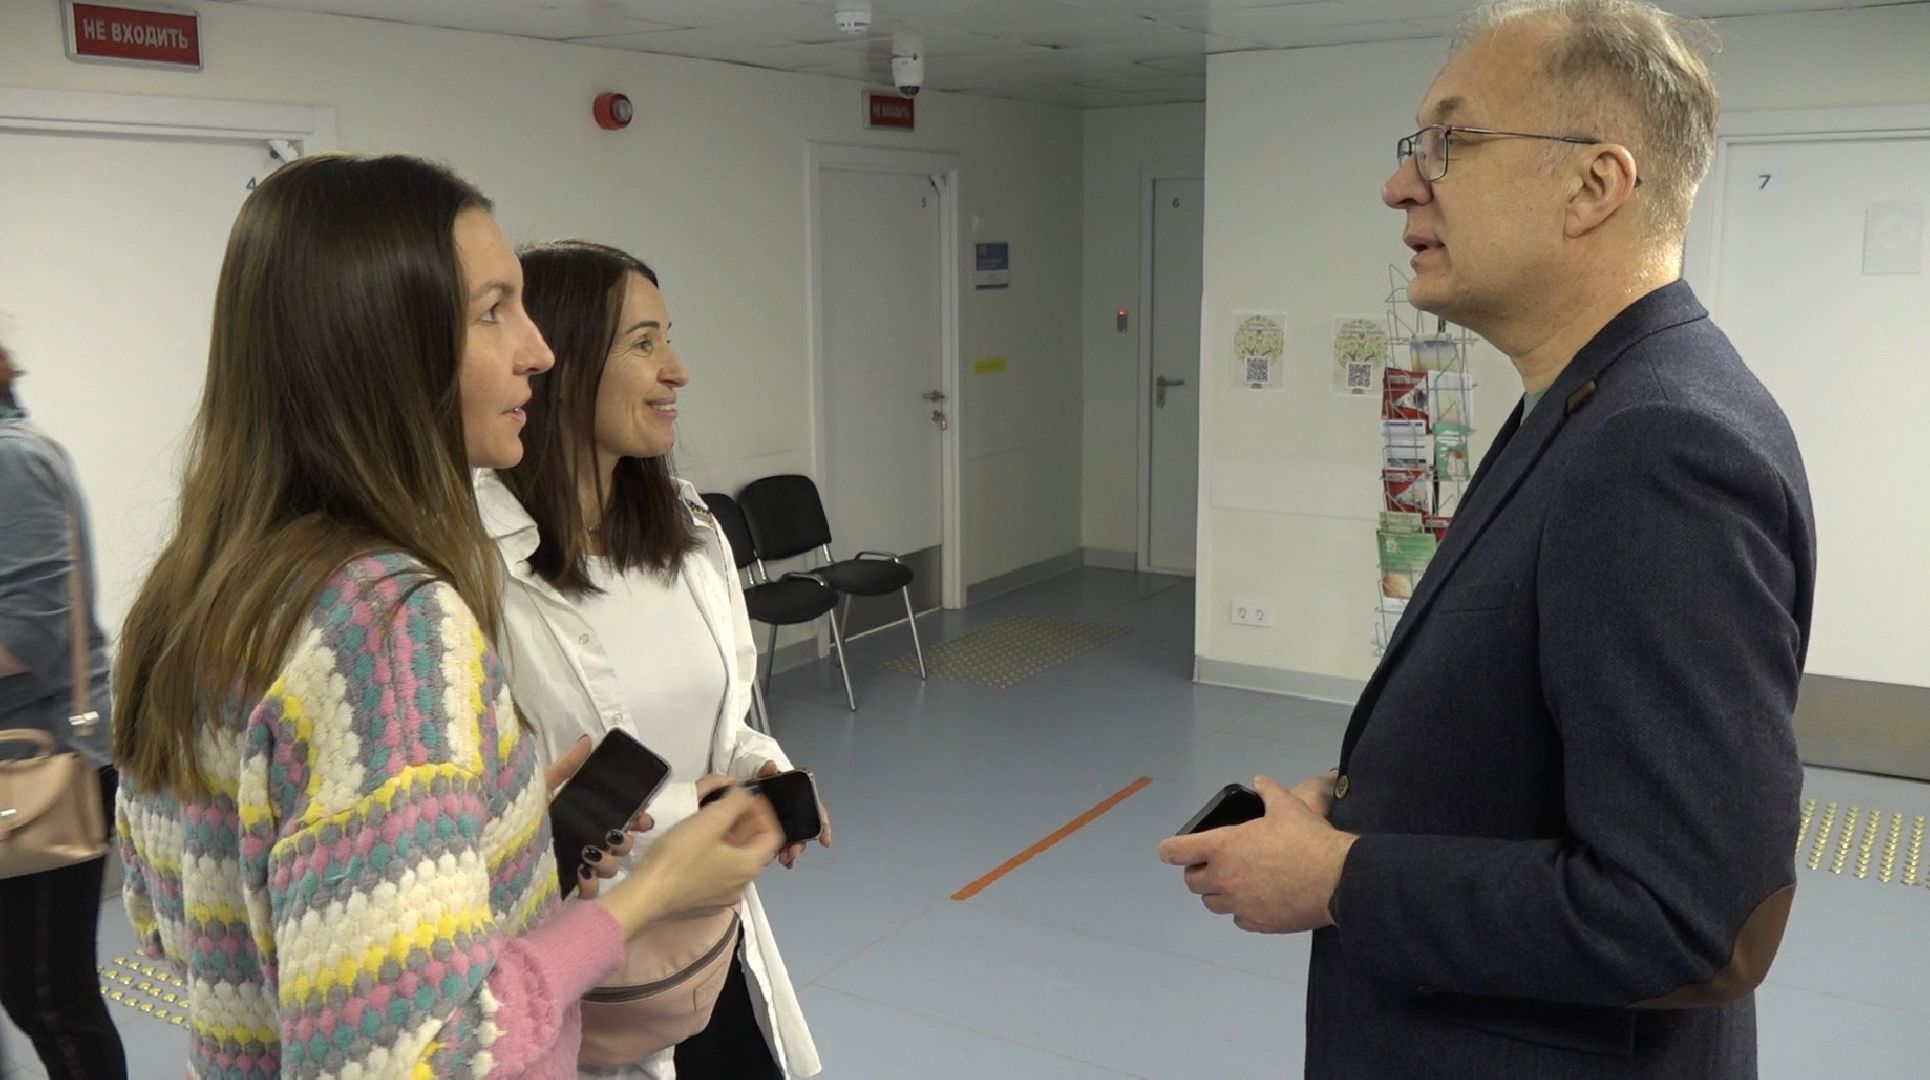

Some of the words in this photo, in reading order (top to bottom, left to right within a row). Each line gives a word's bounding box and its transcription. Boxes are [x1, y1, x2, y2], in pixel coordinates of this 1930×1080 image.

[83, 18, 107, 40] НЕ
[111, 21, 188, 49] ВХОДИТЬ
[1758, 174, 1771, 190] 7
[1172, 198, 1180, 209] 6
